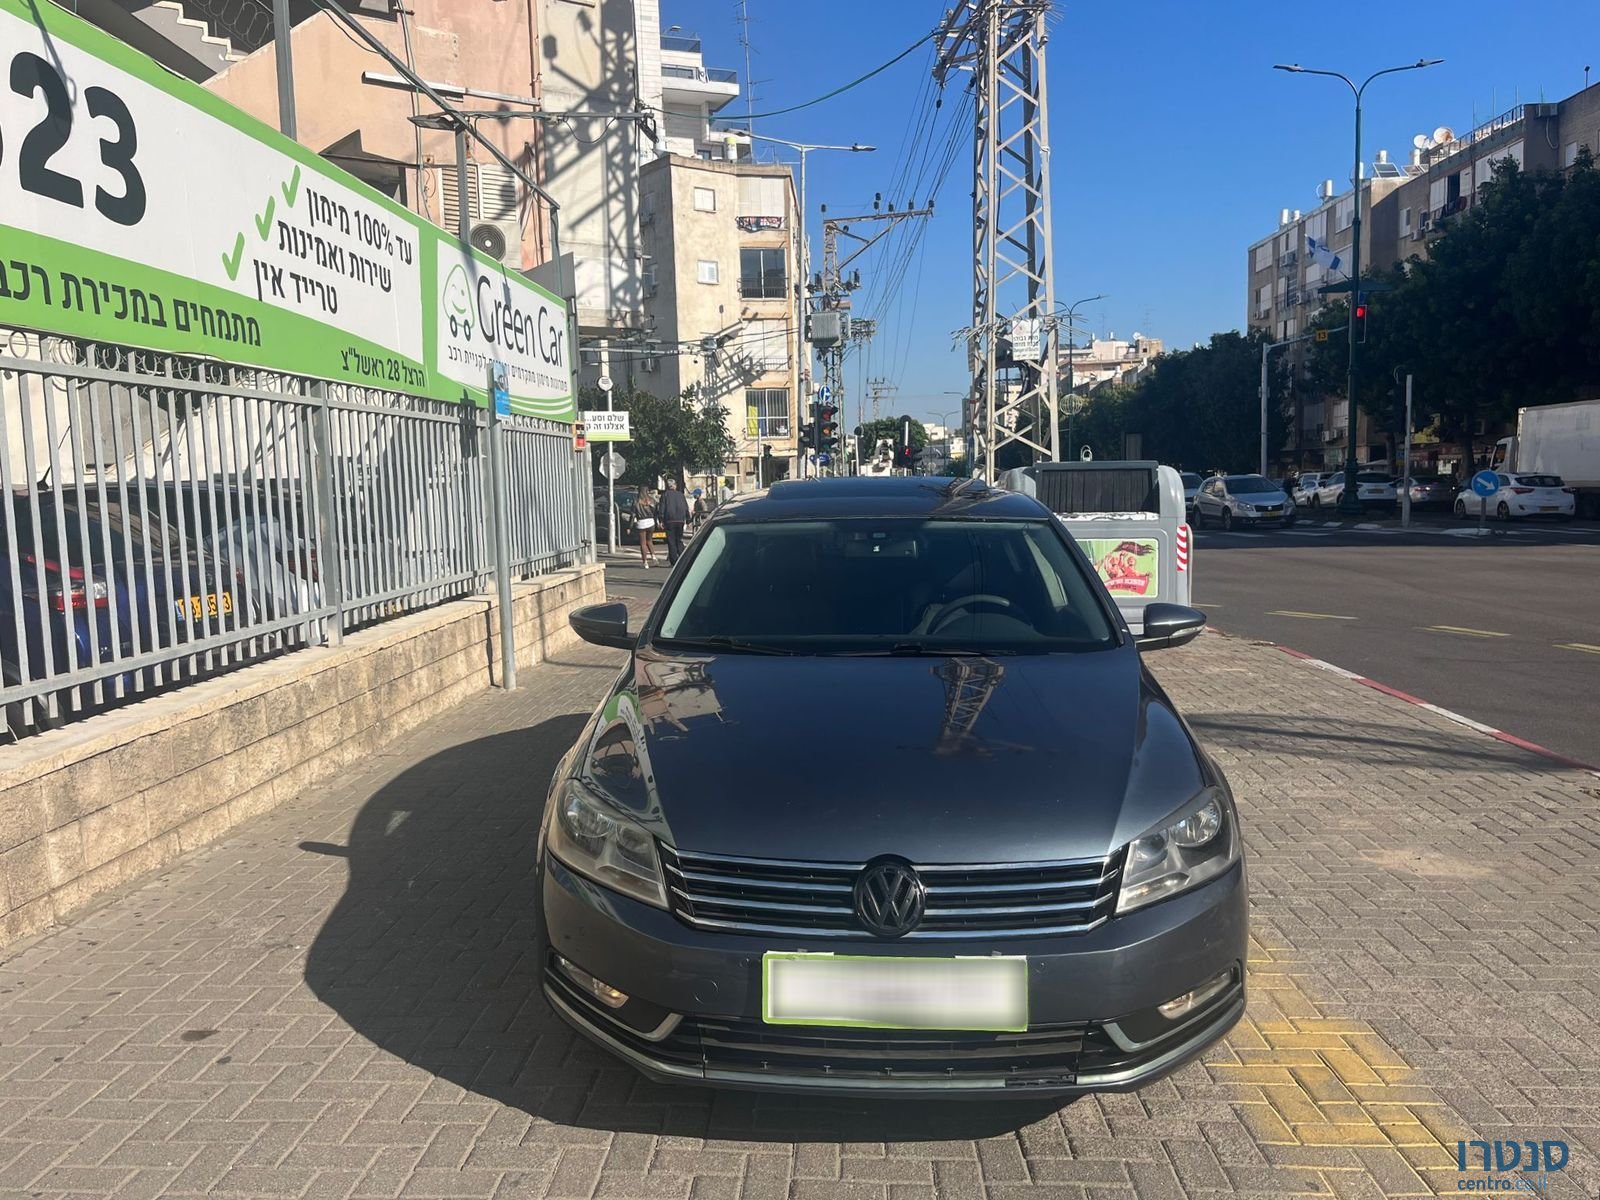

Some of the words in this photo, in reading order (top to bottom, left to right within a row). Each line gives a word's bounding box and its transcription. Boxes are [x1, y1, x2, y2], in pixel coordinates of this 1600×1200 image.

[0, 51, 146, 226] 23
[306, 187, 350, 235] מימון
[278, 220, 345, 275] ואמינות
[354, 210, 394, 256] 100%
[395, 235, 412, 265] עד
[253, 259, 286, 301] אין
[290, 272, 338, 314] טרייד
[349, 251, 392, 293] שירות
[60, 272, 167, 328] במכירת
[173, 298, 261, 347] מתמחים
[477, 275, 535, 358] Green
[538, 306, 563, 368] Car
[387, 358, 401, 382] 28
[447, 344, 462, 362] רכב
[464, 350, 487, 372] לקניית
[402, 361, 425, 388] הרצל
[604, 422, 625, 430] אצלנו
[607, 413, 624, 422] שלם
